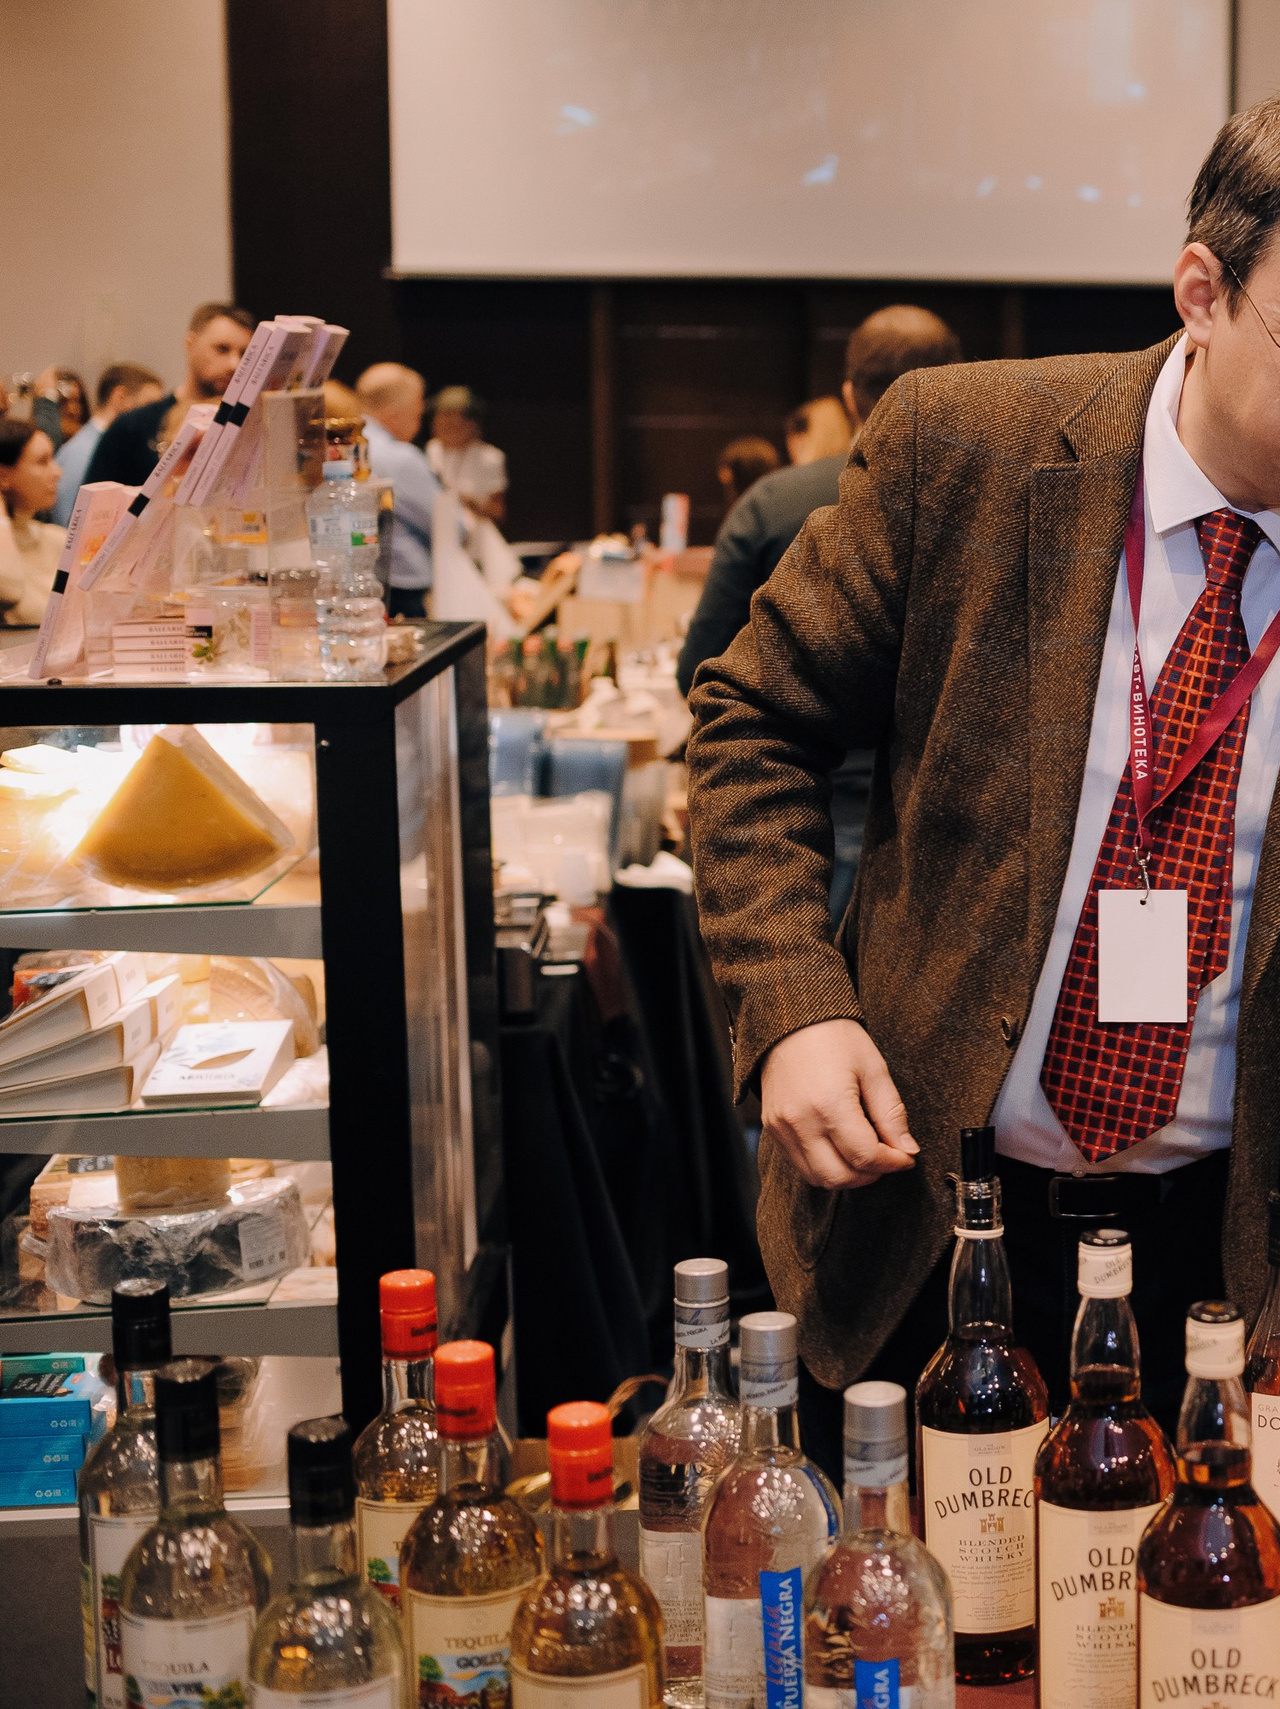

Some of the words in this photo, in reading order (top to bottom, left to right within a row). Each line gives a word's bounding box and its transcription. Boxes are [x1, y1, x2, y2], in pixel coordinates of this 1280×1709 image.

[969, 1466, 1012, 1486] OLD
[934, 1488, 1034, 1518] DUMBREC
[959, 1534, 1025, 1546] BLENDED
[959, 1542, 1024, 1555] SCOTCH
[959, 1550, 1024, 1562] WHISKY
[1088, 1547, 1135, 1568] OLD
[1051, 1571, 1136, 1601] DUMBR
[778, 1577, 796, 1641] NEGRA
[1076, 1624, 1136, 1633] BLEND
[1076, 1633, 1136, 1641] SCOTC
[1077, 1641, 1136, 1649] WHISK
[1191, 1647, 1241, 1669] OLD
[874, 1668, 890, 1709] GRA
[1152, 1674, 1279, 1701] DUMBRECK
